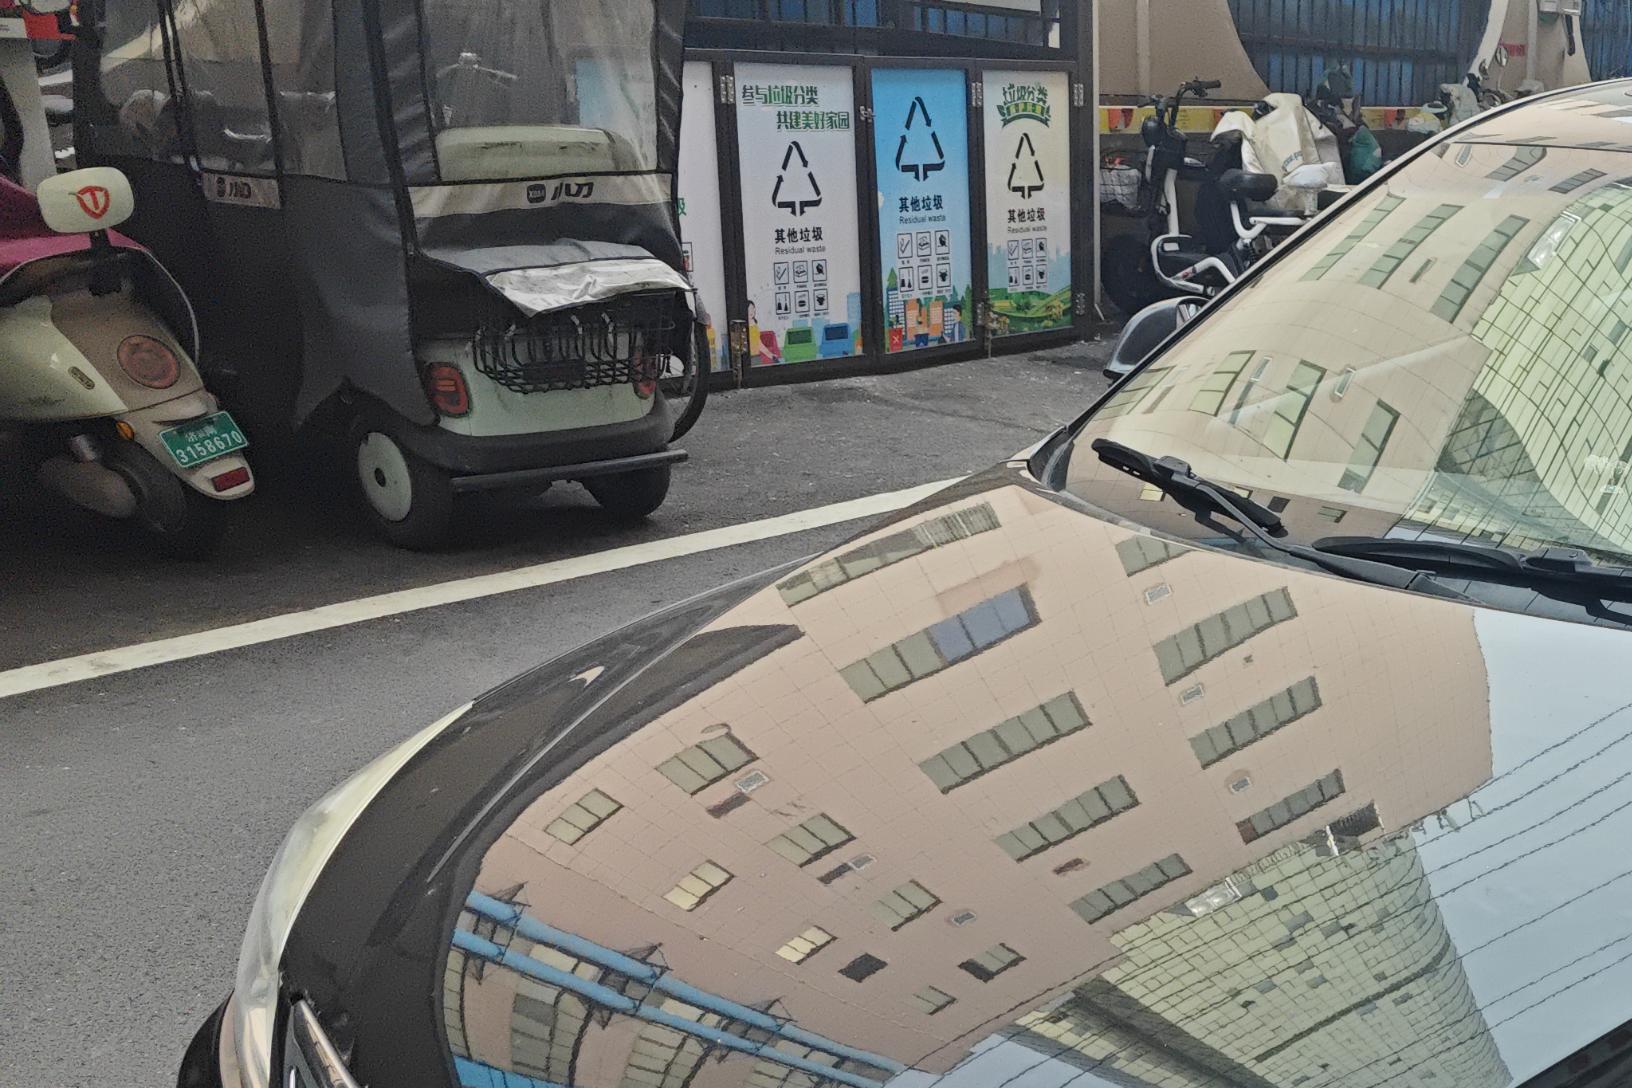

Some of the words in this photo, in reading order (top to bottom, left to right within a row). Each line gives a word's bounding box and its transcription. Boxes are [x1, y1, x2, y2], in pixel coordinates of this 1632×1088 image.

[742, 85, 819, 105] 参与垃圾分类
[1002, 82, 1049, 106] 垃圾分类
[776, 110, 850, 130] 共建美好家园
[898, 194, 944, 213] 其他垃圾
[1008, 207, 1046, 223] 其他垃圾
[774, 226, 823, 244] 其他垃圾
[774, 245, 804, 255] Residual
[176, 430, 242, 463] 3158670
